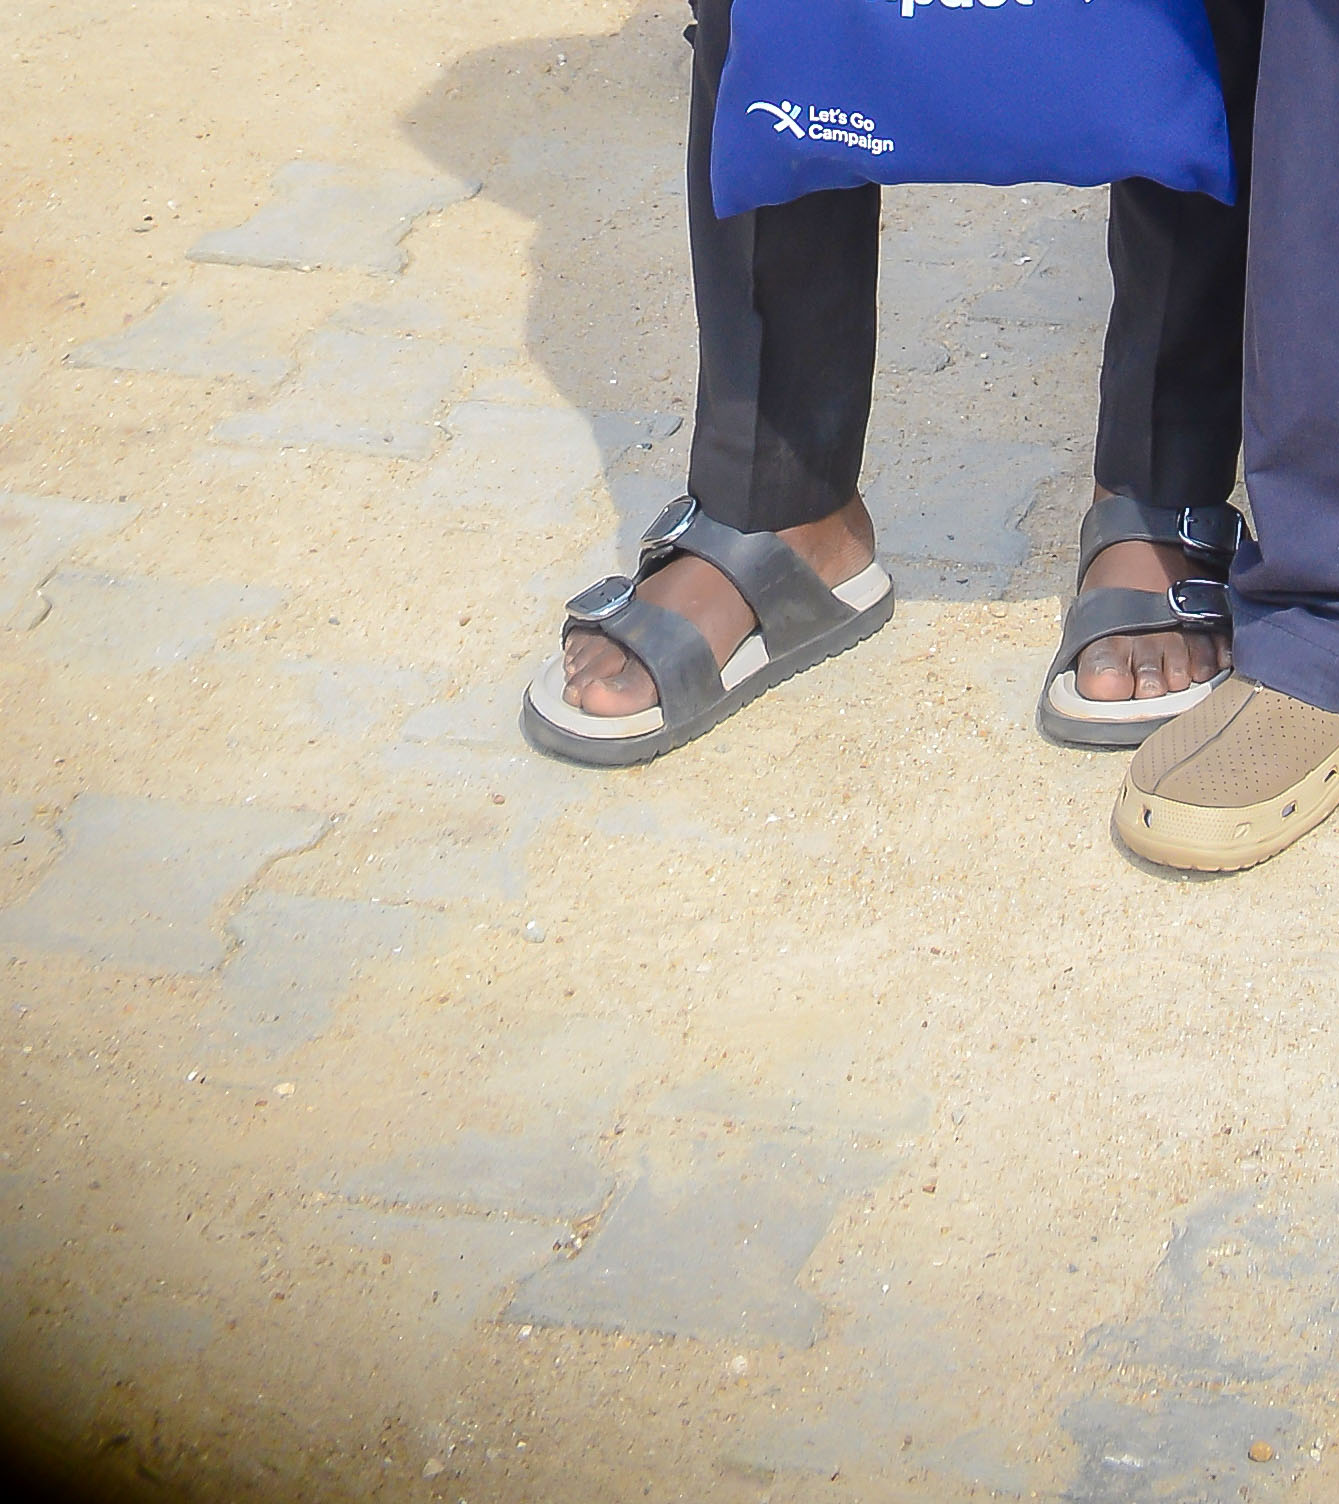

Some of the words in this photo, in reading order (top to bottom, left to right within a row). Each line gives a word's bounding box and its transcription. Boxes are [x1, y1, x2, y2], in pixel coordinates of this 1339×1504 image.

[808, 104, 848, 128] Let's
[850, 110, 876, 133] Go
[807, 123, 895, 155] Campaign
